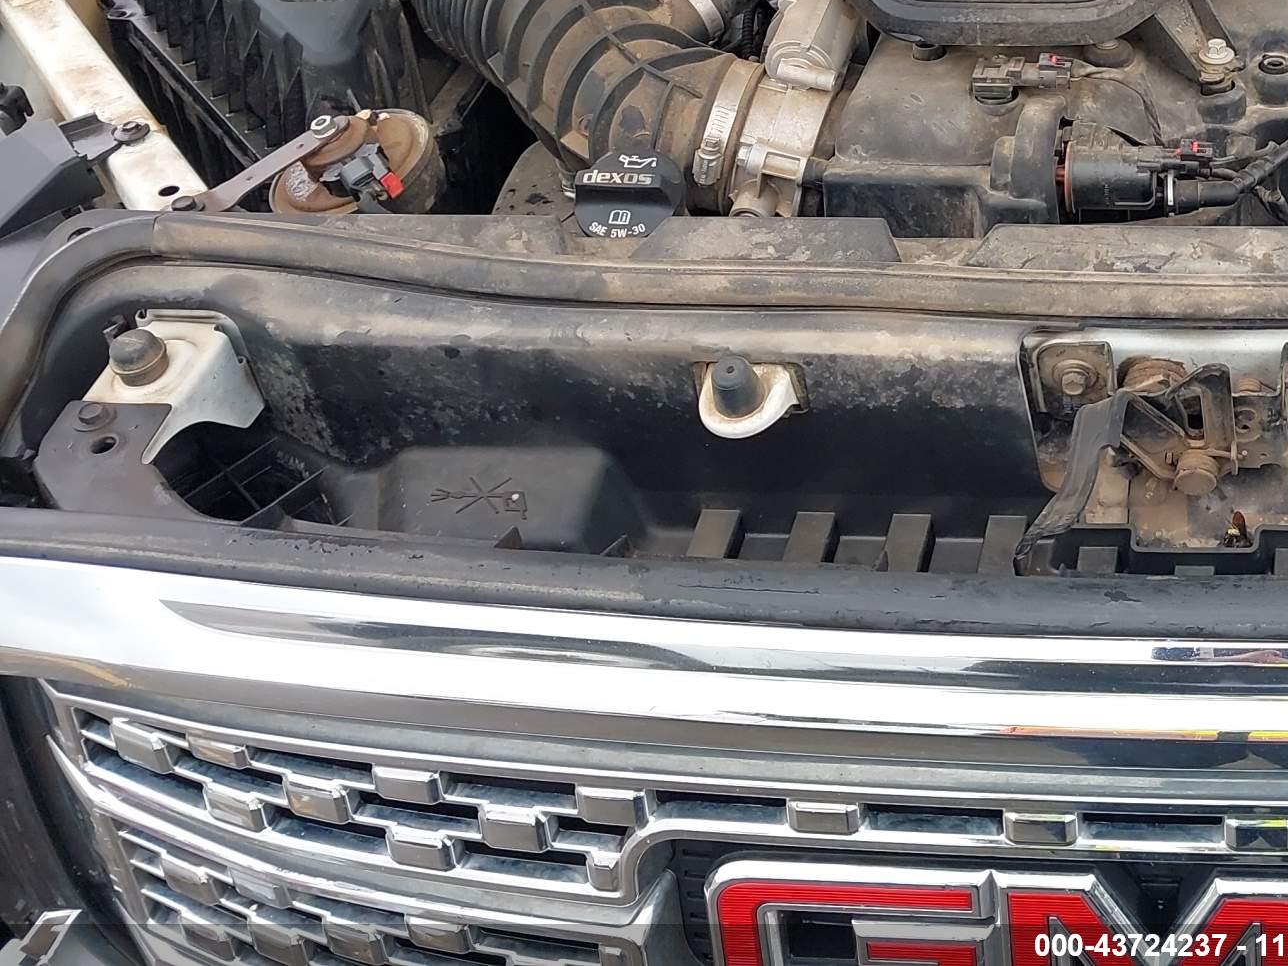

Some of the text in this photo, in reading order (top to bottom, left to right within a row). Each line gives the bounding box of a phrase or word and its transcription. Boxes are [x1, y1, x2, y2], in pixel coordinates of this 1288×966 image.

[583, 170, 656, 185] dexos
[589, 221, 646, 238] SAE 5W-30
